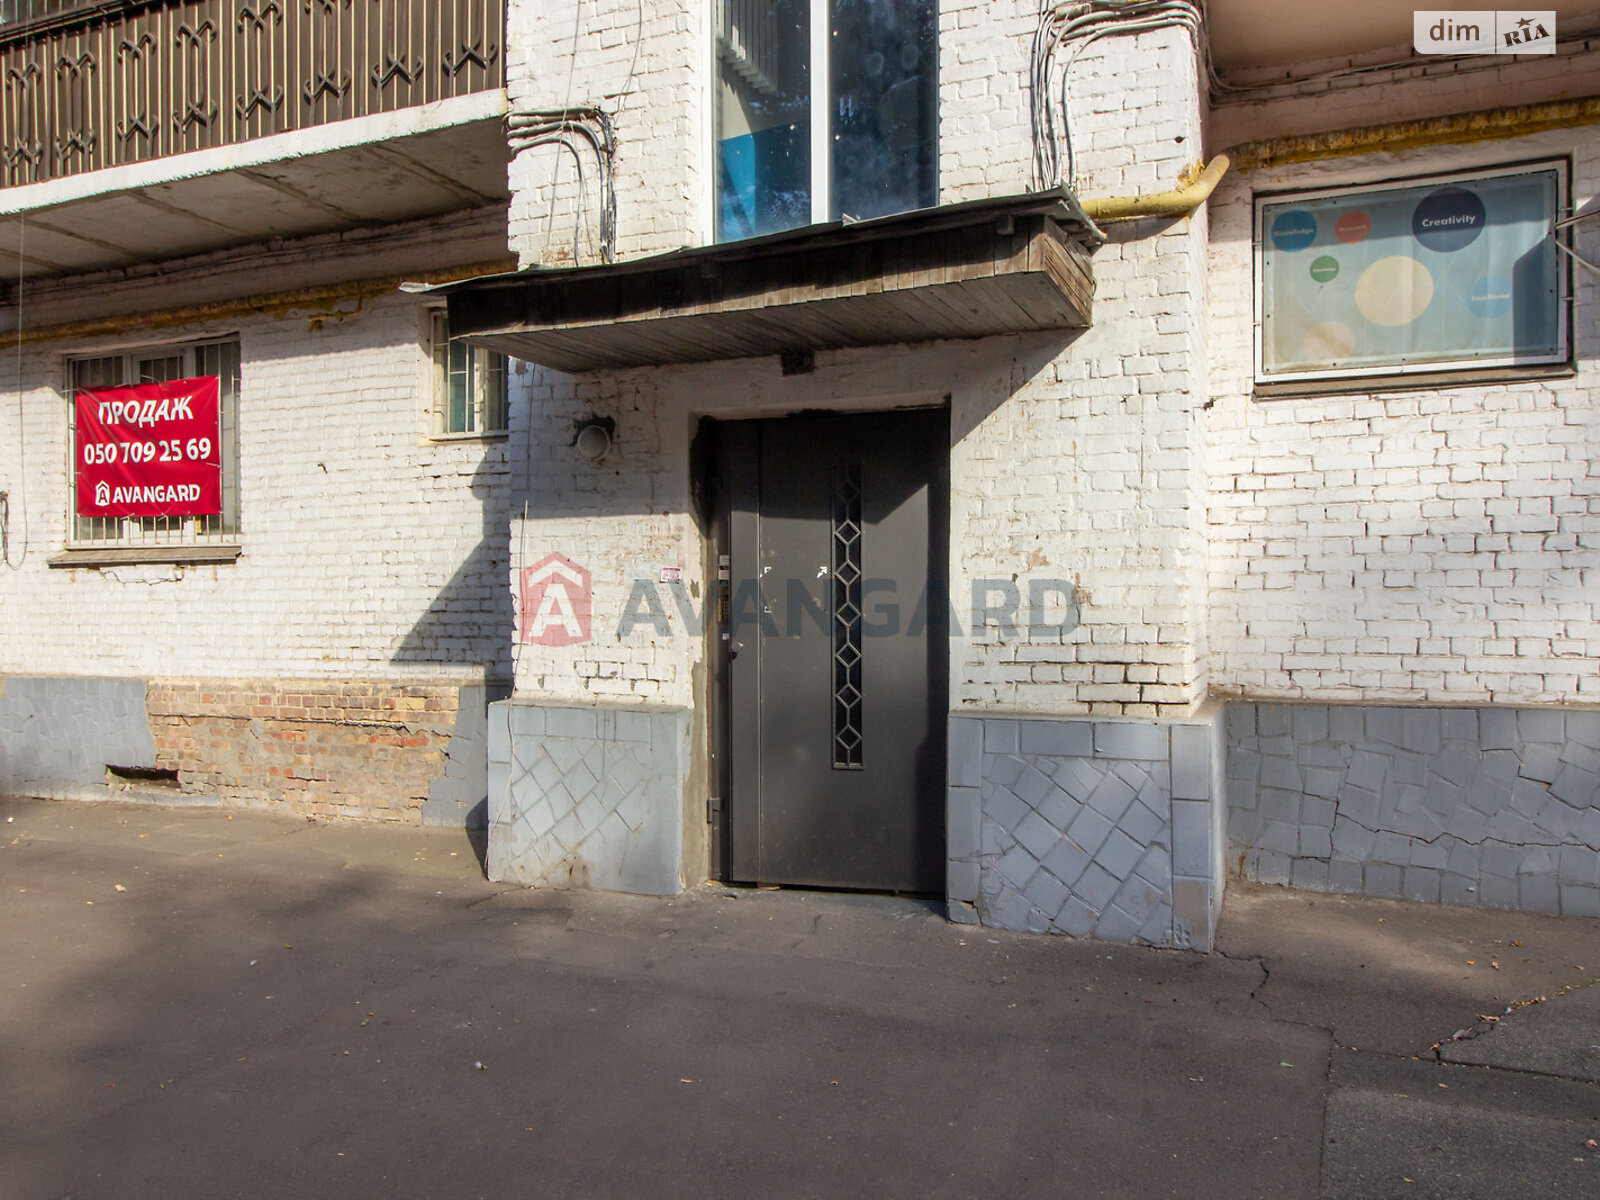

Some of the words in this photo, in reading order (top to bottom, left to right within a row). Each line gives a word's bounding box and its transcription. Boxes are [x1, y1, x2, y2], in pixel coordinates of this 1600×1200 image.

[1422, 215, 1476, 227] Creativity
[99, 396, 193, 427] ПРОДАЖ
[84, 444, 117, 464] 050
[120, 442, 155, 463] 709
[159, 440, 182, 462] 25
[187, 437, 211, 460] 69
[112, 484, 200, 503] AVANGARD
